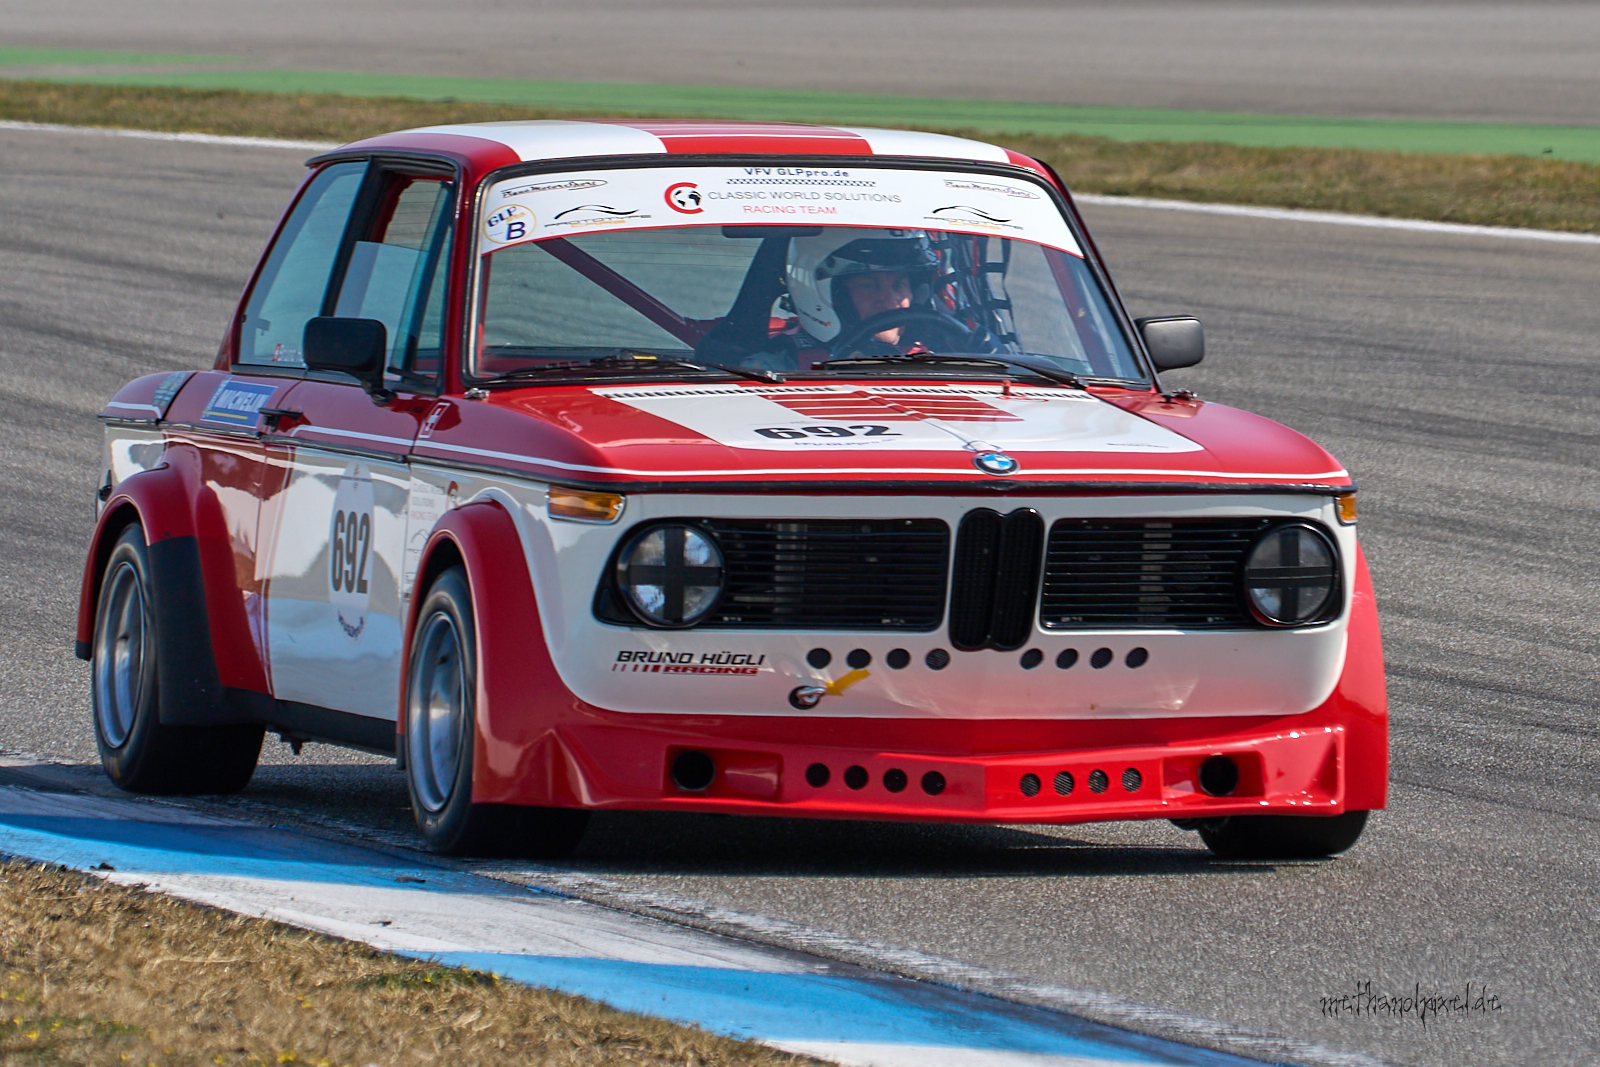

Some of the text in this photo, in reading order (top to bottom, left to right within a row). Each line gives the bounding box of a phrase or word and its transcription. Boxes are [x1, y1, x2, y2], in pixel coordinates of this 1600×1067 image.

[744, 168, 849, 178] VFV GLPpro.de
[708, 191, 902, 203] CLASSIC WORLD SOLUTIONS
[487, 206, 517, 228] GLP
[743, 205, 838, 215] RACING TEAM
[506, 221, 526, 241] B
[753, 425, 904, 442] 692
[332, 509, 371, 594] 692
[616, 651, 766, 666] BRUNO HÜGLI
[662, 665, 760, 675] RACING
